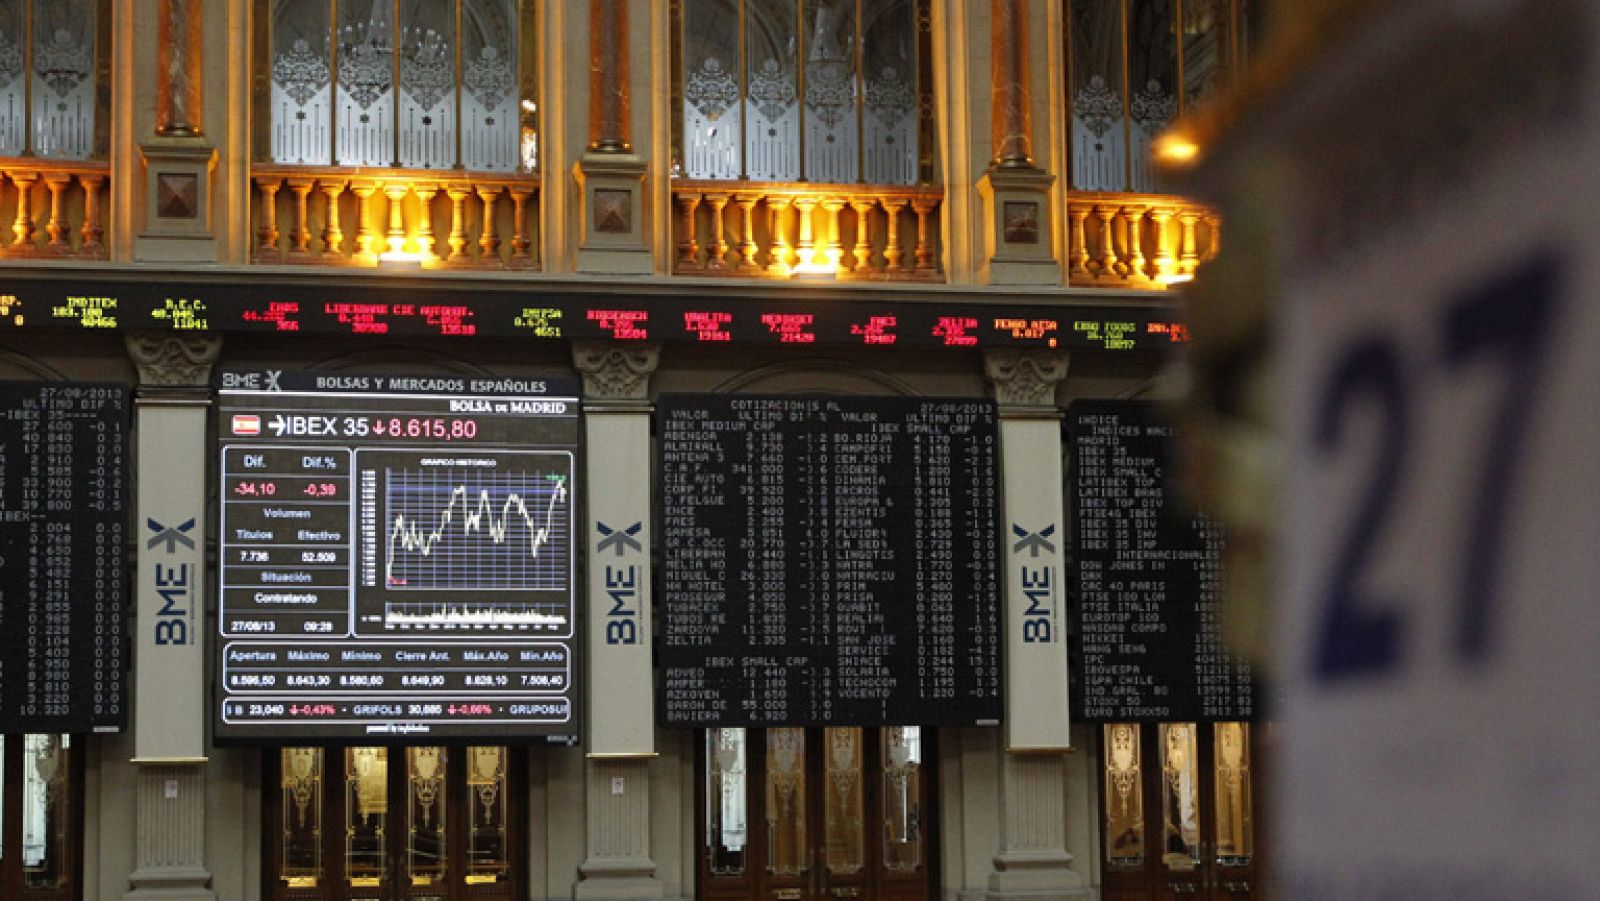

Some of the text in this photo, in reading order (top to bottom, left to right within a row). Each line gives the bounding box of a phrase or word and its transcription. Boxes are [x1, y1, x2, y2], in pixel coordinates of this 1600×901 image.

[316, 377, 370, 389] BOLSAS
[374, 378, 382, 389] Y
[389, 379, 464, 391] MERCADOS
[470, 379, 547, 393] ESPAÑOLES
[450, 400, 492, 412] BOLSA
[510, 402, 566, 414] MADRID
[286, 416, 477, 440] IBEX 35 8.615,80
[702, 421, 746, 430] MEDIUM
[1312, 243, 1568, 688] 27
[262, 508, 311, 519] Volumen
[297, 530, 341, 542] Efectivo
[1131, 582, 1165, 591] PARIS
[254, 592, 318, 604] Contratando
[1083, 613, 1131, 622] EUROTOP
[230, 650, 277, 662] Apertura
[395, 650, 427, 661] Cierre
